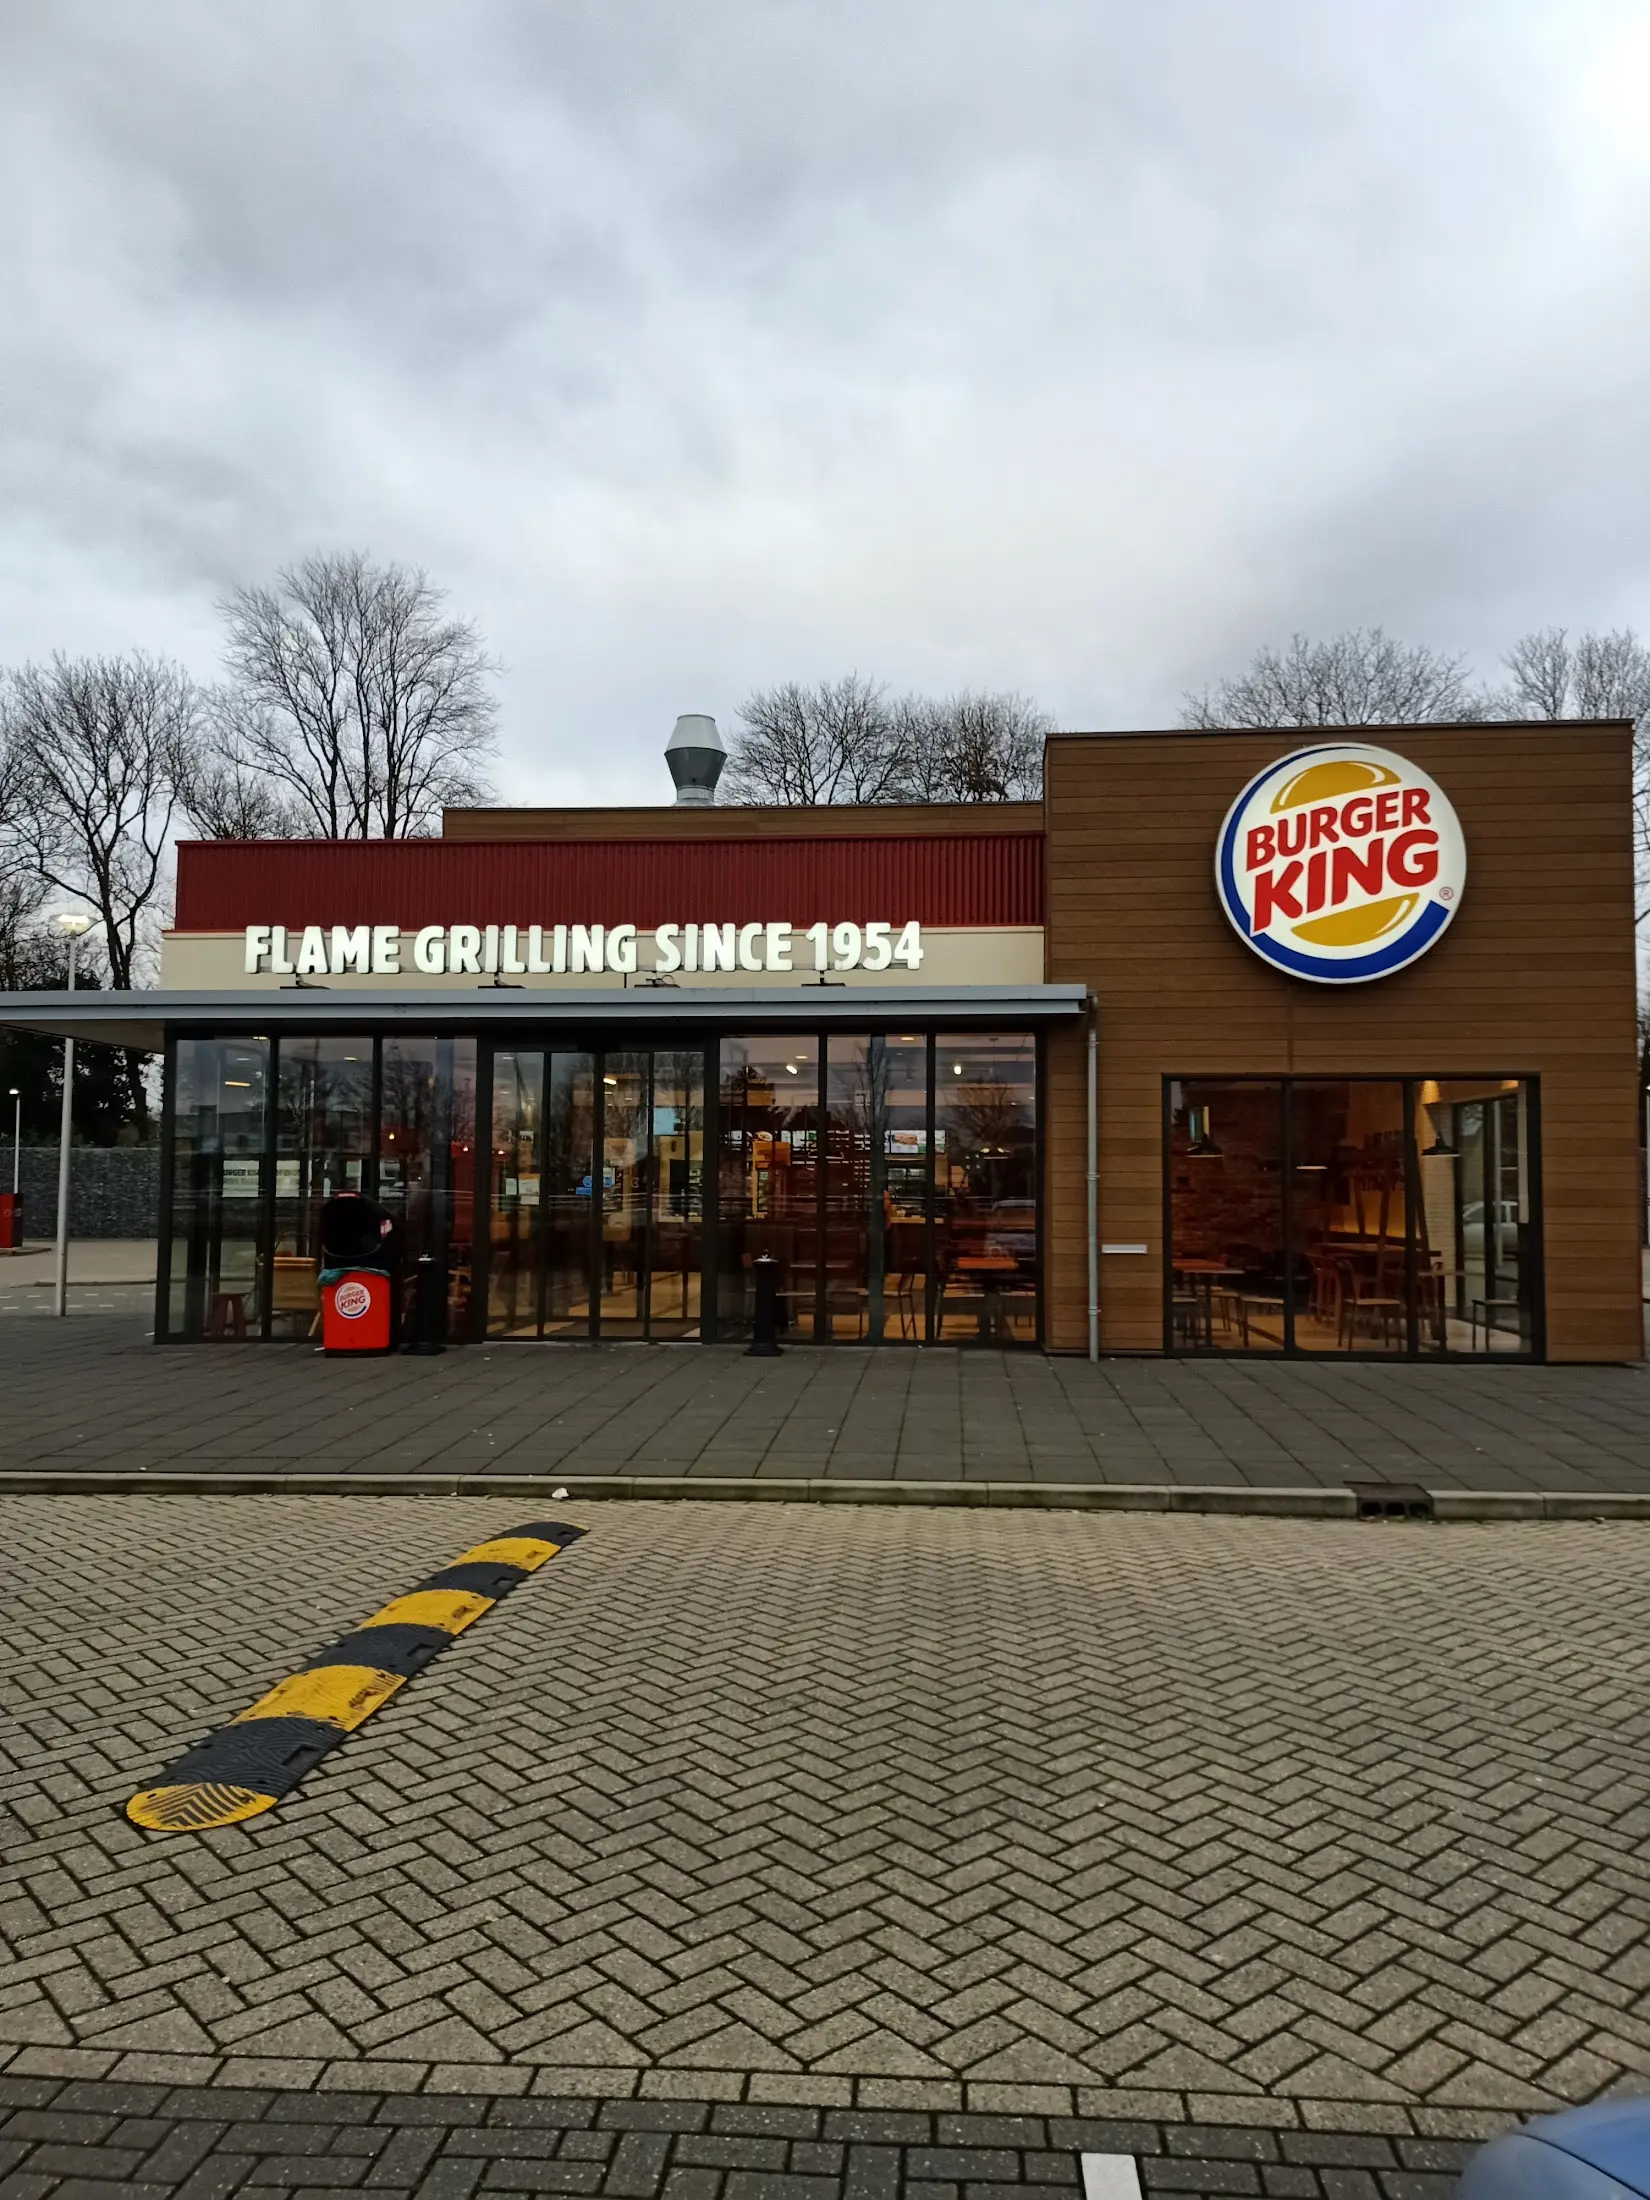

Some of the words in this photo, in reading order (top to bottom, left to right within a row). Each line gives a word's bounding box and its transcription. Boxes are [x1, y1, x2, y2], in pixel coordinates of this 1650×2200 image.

[1247, 788, 1431, 872] BURGER
[1253, 829, 1439, 932] KING
[244, 925, 400, 974] FLAME
[413, 923, 637, 974] GRILLING
[655, 922, 793, 973] SINCE
[805, 921, 924, 972] 1954
[340, 1289, 365, 1302] BURGER
[340, 1296, 366, 1310] KING
